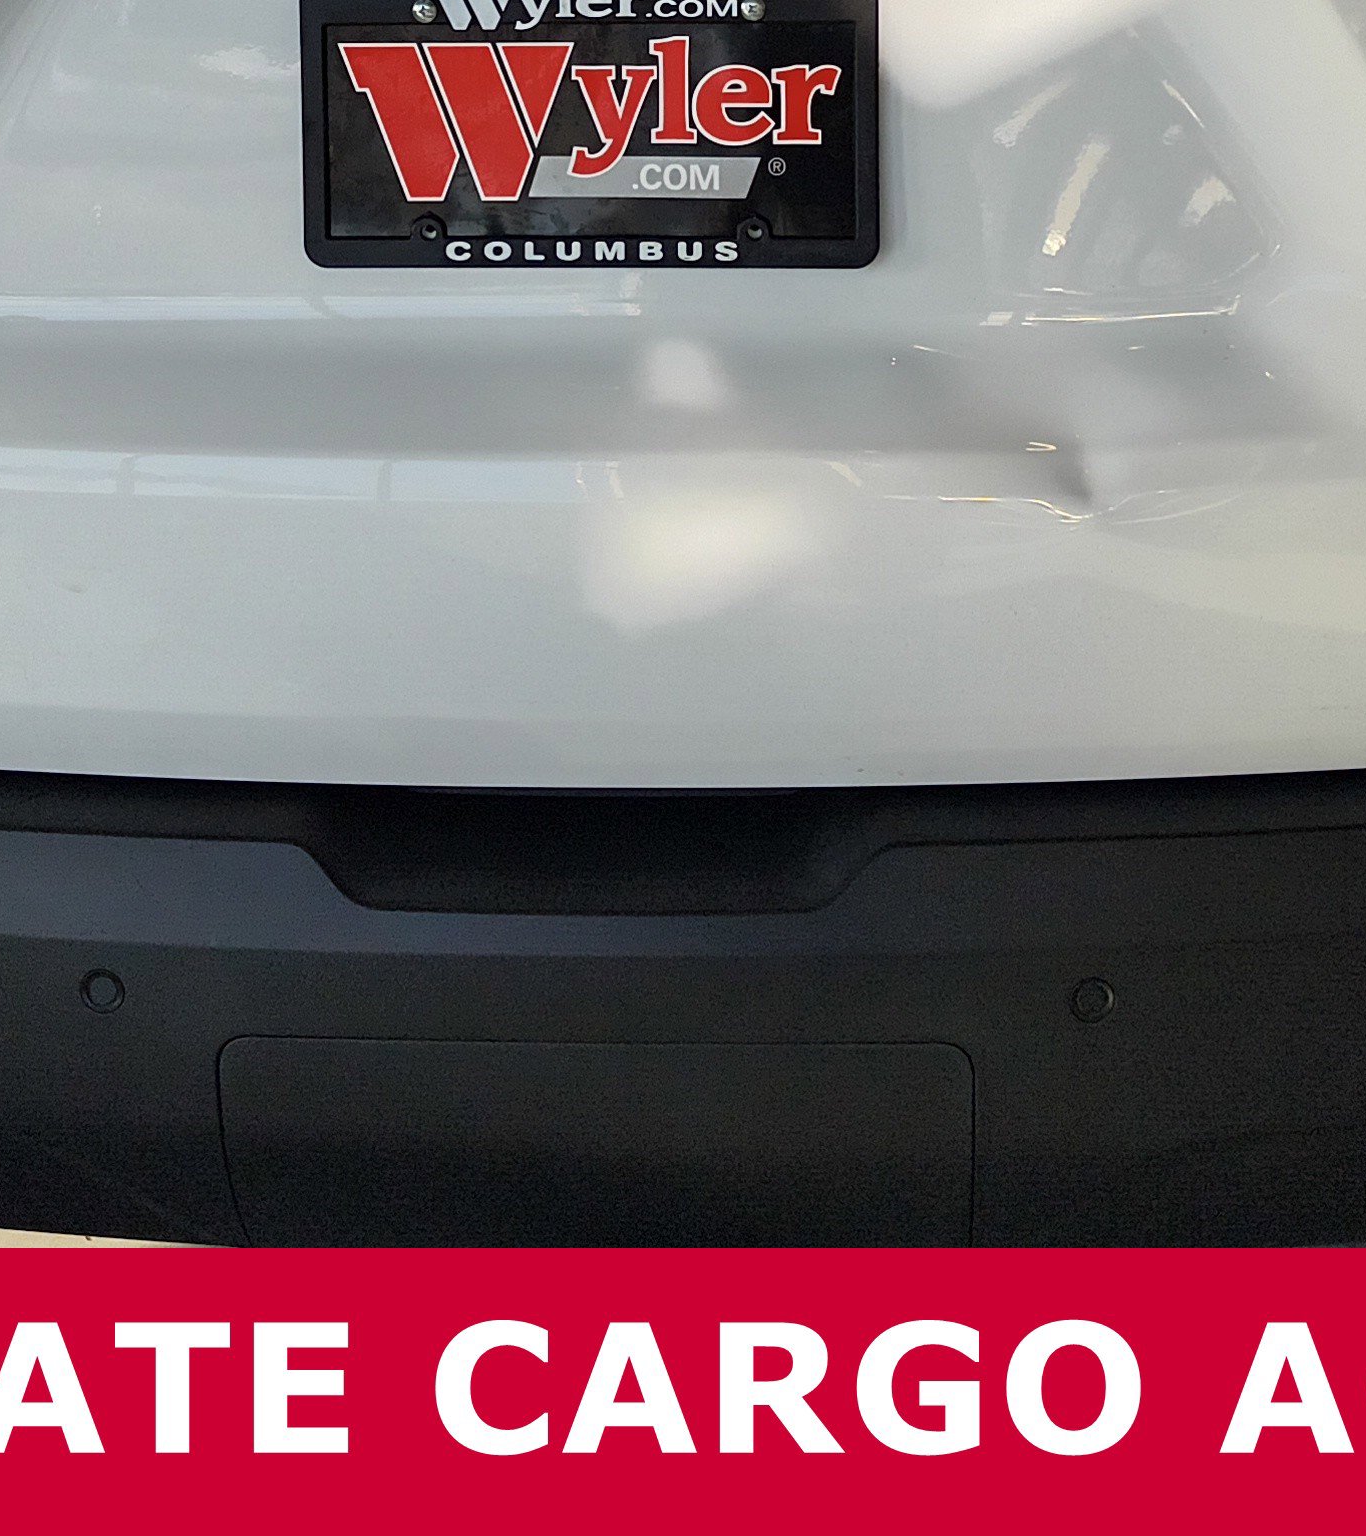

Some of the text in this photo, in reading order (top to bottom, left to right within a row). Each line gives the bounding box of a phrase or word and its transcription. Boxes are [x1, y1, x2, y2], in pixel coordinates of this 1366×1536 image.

[337, 35, 843, 202] Wyler
[631, 163, 721, 191] .COM
[445, 239, 739, 263] COLUMBUS
